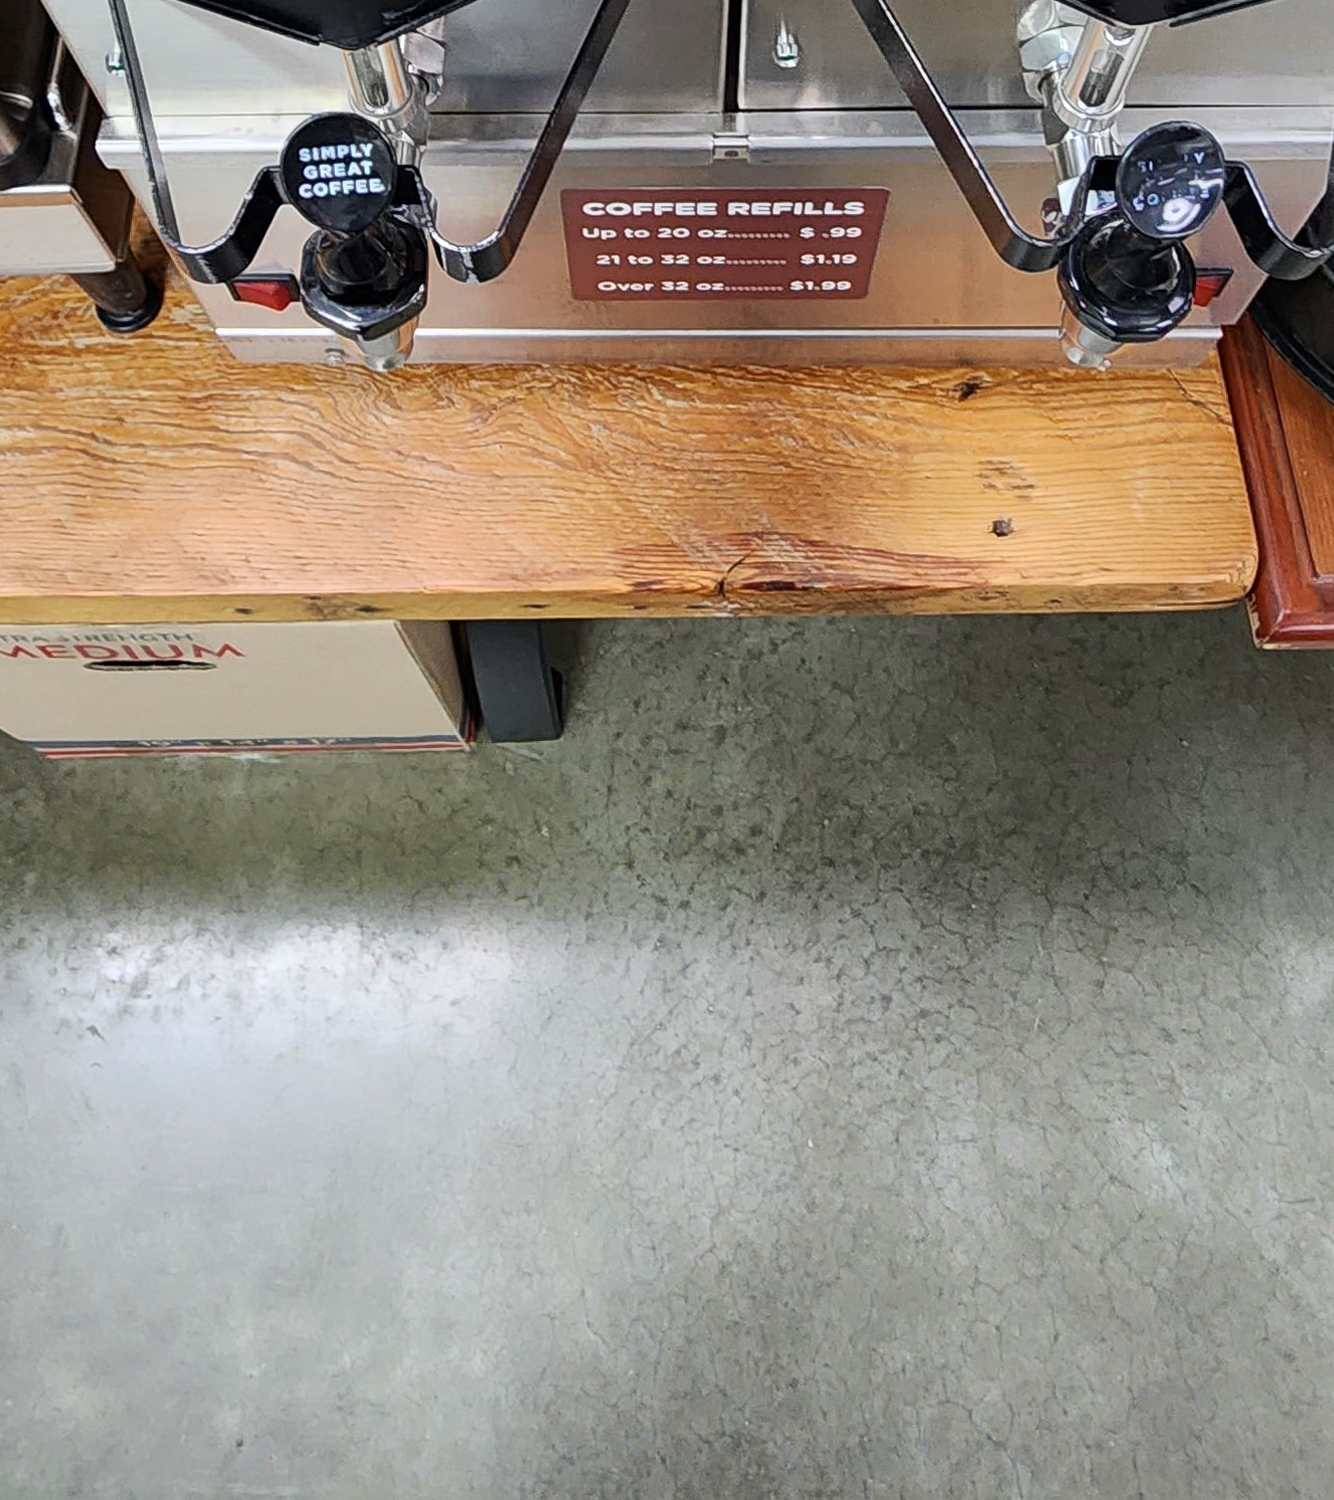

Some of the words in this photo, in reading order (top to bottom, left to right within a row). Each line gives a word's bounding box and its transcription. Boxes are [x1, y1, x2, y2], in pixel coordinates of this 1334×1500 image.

[298, 143, 373, 162] SIMPLY
[303, 160, 373, 180] GREAT
[298, 178, 383, 199] COFFEE
[582, 202, 718, 216] COFFEE
[727, 202, 865, 216] REFILLS
[582, 227, 617, 240] Up
[624, 228, 650, 239] to
[657, 227, 690, 239] 20
[800, 226, 815, 240] $
[596, 255, 620, 265] 21
[627, 255, 653, 265] to
[661, 254, 689, 265] 32
[800, 254, 857, 266] $1.19
[597, 281, 654, 292] Over
[661, 281, 689, 291] 32
[790, 281, 851, 291] $1.99
